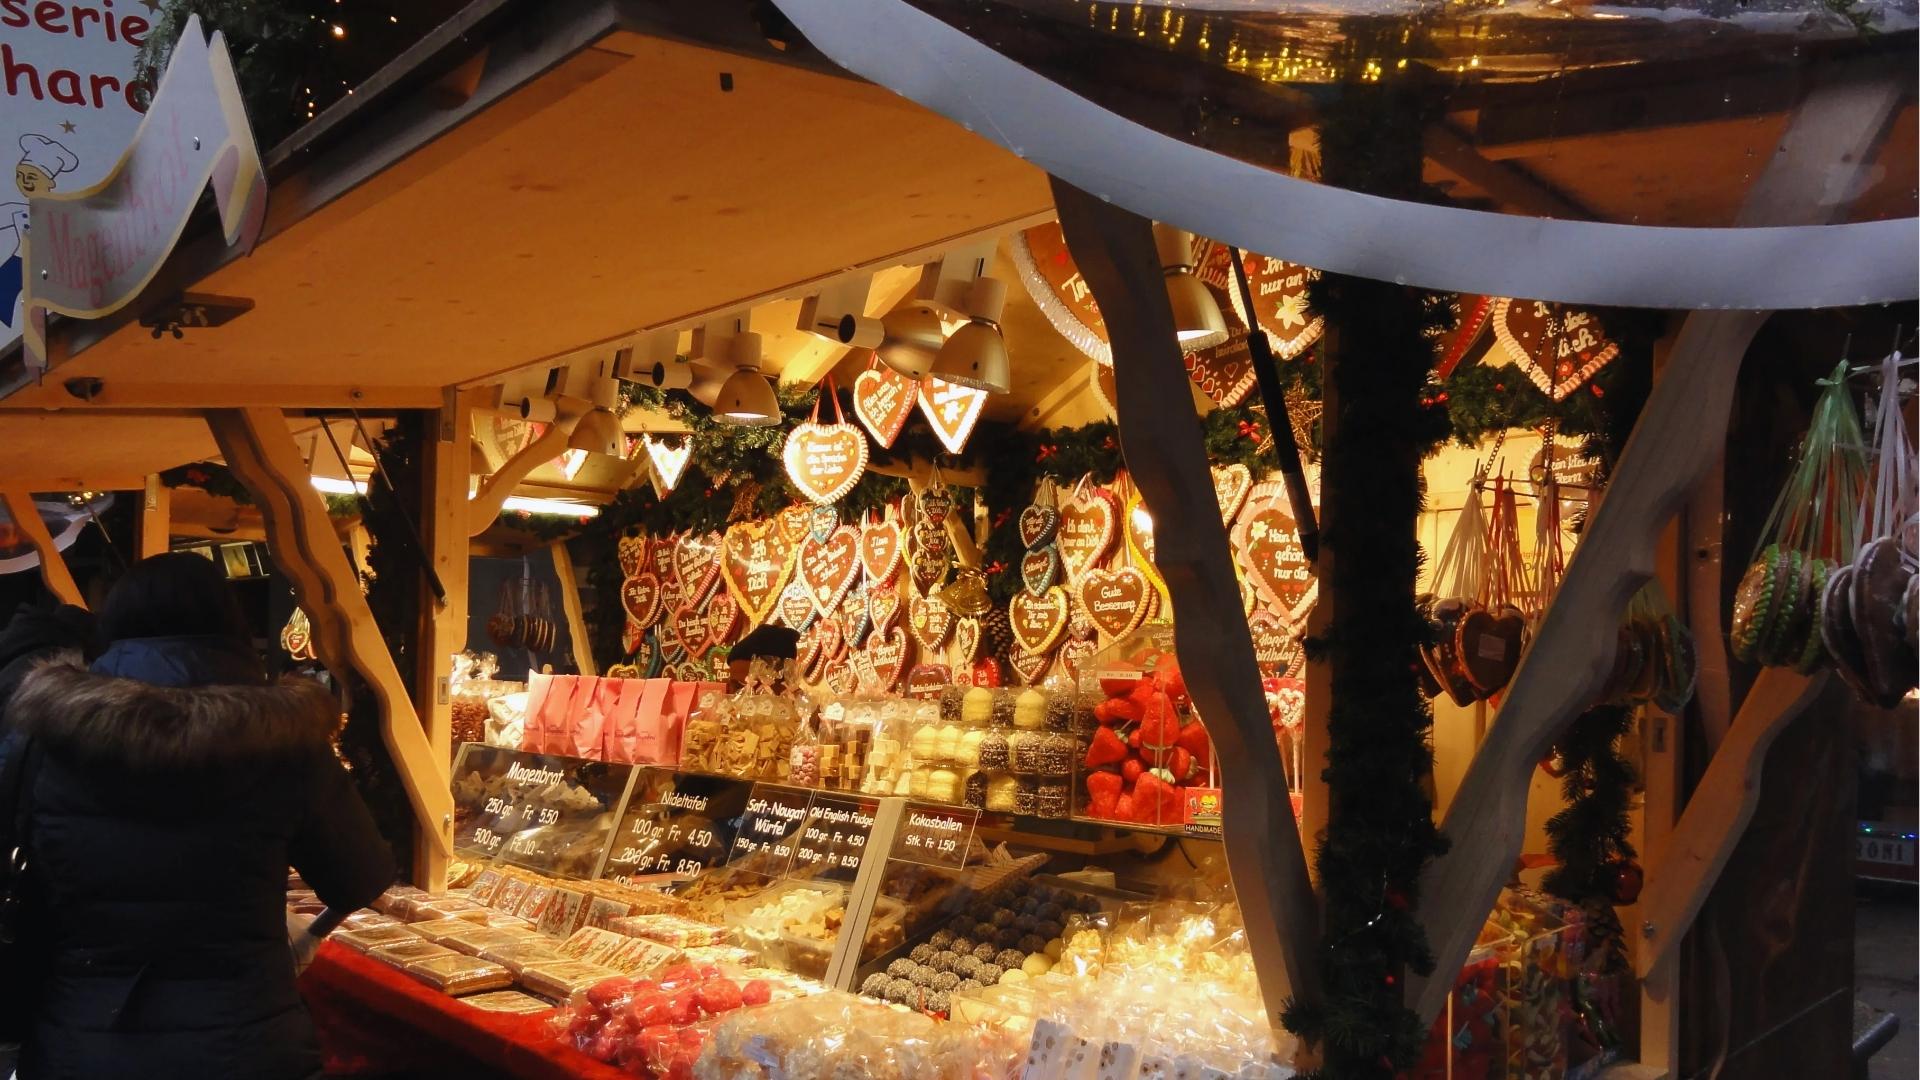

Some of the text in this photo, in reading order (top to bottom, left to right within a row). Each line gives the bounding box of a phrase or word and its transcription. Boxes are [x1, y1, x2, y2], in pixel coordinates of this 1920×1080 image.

[48, 112, 190, 308] Magenbrot
[1101, 586, 1122, 599] Gute
[1094, 601, 1137, 614] Besserung
[1259, 632, 1290, 647] Happy
[506, 761, 564, 787] Magenbrot
[485, 797, 503, 814] 250
[754, 818, 787, 836] Würfel
[810, 806, 875, 828] Old English Fudge
[909, 812, 963, 833] Kokosballen
[473, 828, 492, 845] 500
[631, 818, 652, 836] 100
[667, 824, 681, 841] Fr.
[687, 828, 712, 848] 4.50
[804, 827, 819, 839] 100
[847, 834, 865, 847] 4.50
[1185, 824, 1222, 835] HANDMADE
[736, 837, 750, 849] 150
[774, 845, 790, 857] 8.50
[905, 834, 921, 847] Stk.
[621, 846, 642, 865] 200
[656, 853, 671, 872] Fr.
[676, 859, 701, 878] 8.50
[797, 847, 813, 860] 200
[840, 855, 859, 868] 8.50
